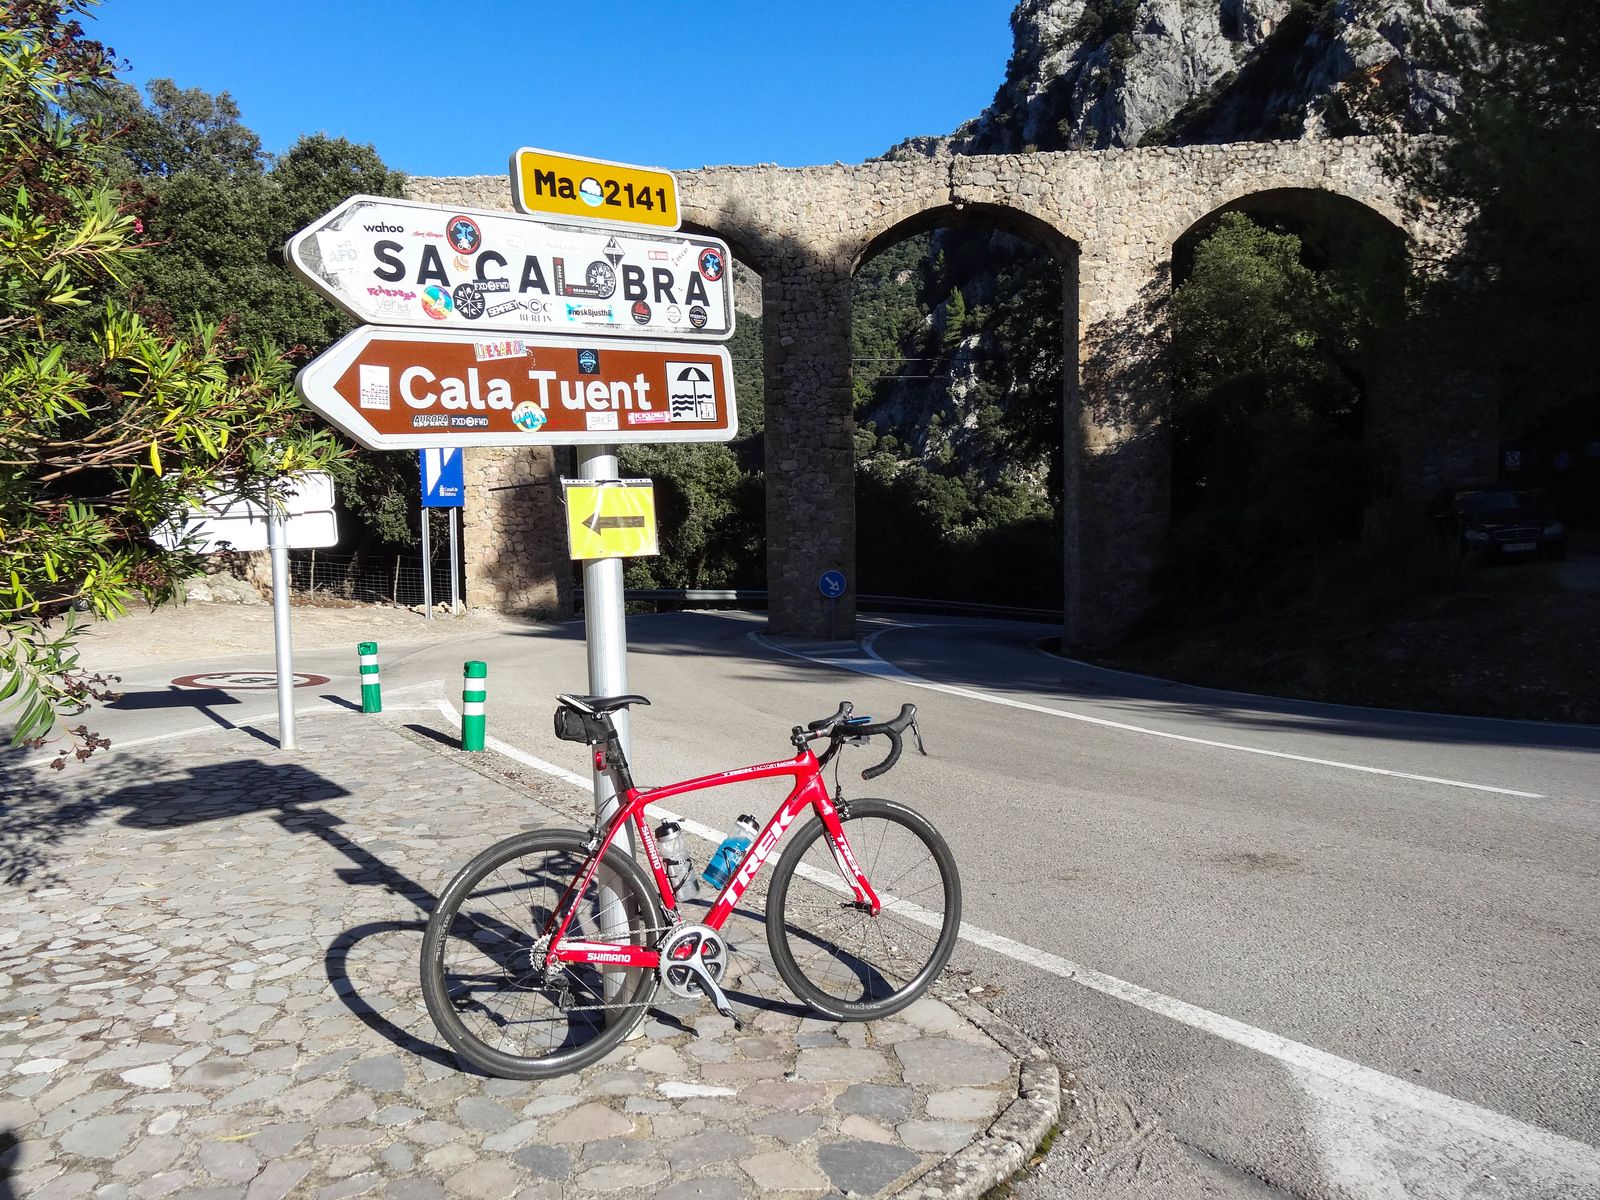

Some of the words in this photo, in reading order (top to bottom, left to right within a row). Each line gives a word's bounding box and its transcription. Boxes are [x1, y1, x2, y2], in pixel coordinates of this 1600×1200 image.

[534, 168, 577, 200] Ma
[604, 179, 666, 213] 2141
[363, 221, 404, 233] wahoo
[373, 239, 451, 287] SA
[475, 249, 710, 307] CABRA
[399, 365, 515, 410] Cala
[528, 369, 652, 411] Tuent
[413, 414, 449, 423] AURORA
[451, 417, 466, 426] FXD
[474, 417, 489, 426] FWD
[642, 825, 662, 870] SHIMANO
[718, 805, 795, 908] TREK
[837, 833, 862, 877] TREK
[587, 952, 631, 963] SHIMANO
